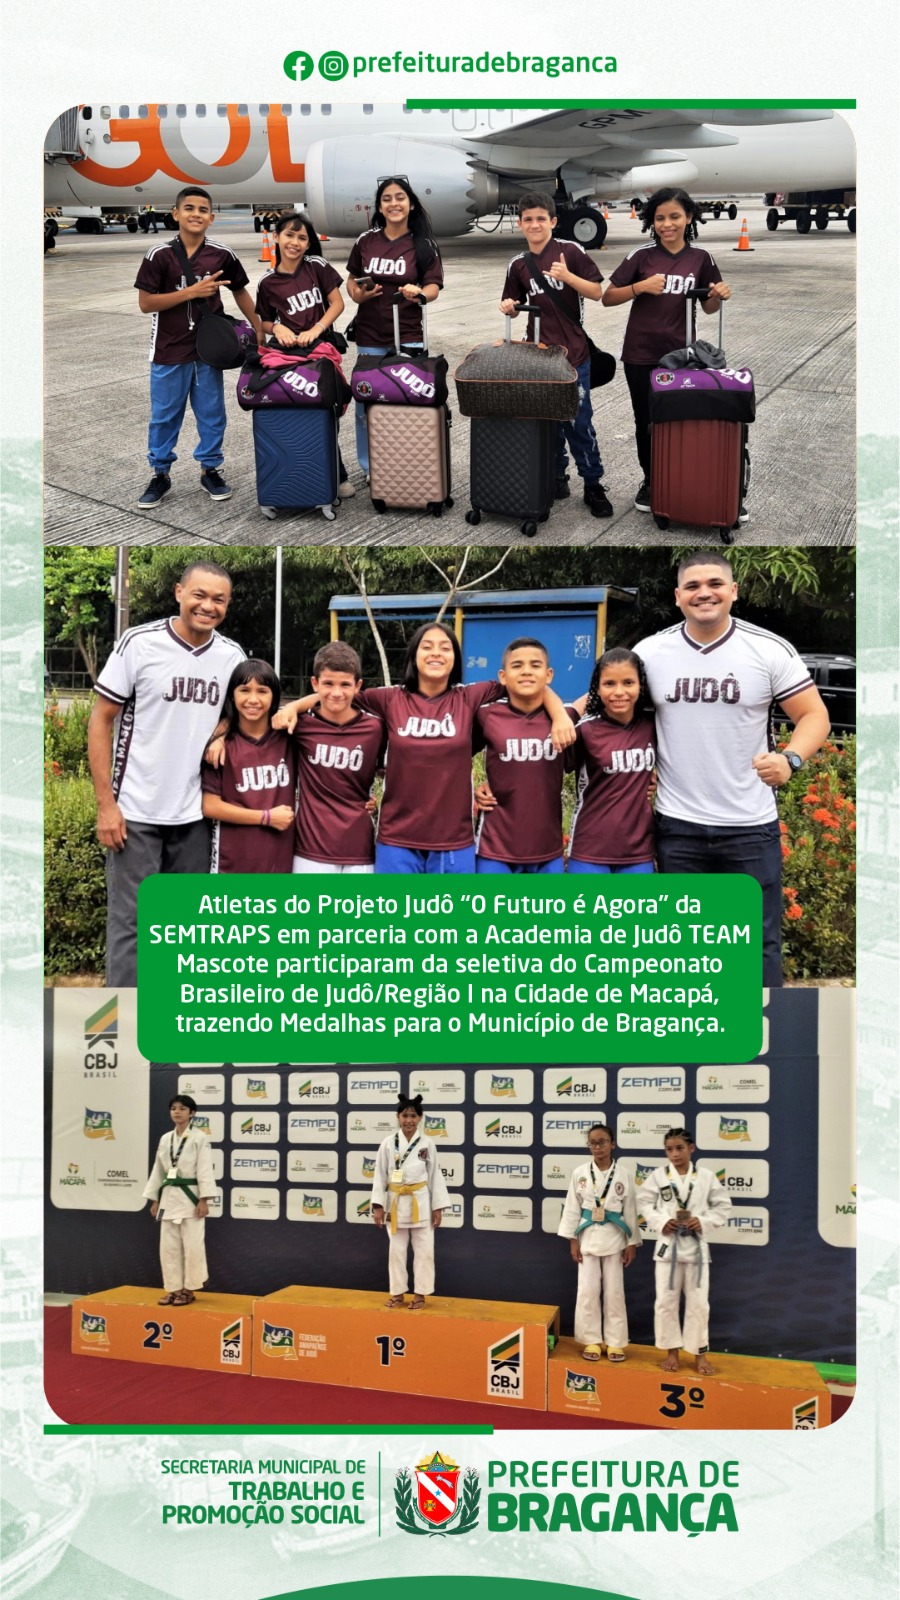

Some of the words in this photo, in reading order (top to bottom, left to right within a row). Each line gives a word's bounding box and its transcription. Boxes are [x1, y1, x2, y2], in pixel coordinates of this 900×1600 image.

[364, 256, 406, 276] JUDÔ
[656, 273, 696, 294] UDÔ
[281, 371, 319, 398] UDÔ
[391, 367, 436, 399] JUDÔ
[162, 676, 220, 706] JUDÔ
[665, 673, 740, 704] JUDÔ
[398, 713, 456, 737] JUDÔ
[308, 745, 363, 771] JUDÔ
[603, 742, 655, 774] JUDÔ
[236, 758, 289, 792] JUDÔ
[84, 1053, 118, 1069] CBJ
[351, 1081, 398, 1090] ZEMPO
[621, 1077, 682, 1087] ZEMPO
[312, 1086, 330, 1095] CBJ
[574, 1084, 596, 1093] CBJ
[254, 1124, 272, 1132] CBJ
[291, 1119, 336, 1128] ZEMPO
[502, 1125, 522, 1134] CBJ
[234, 1159, 277, 1168] ZEMPO
[107, 1170, 129, 1178] COMEL
[441, 1168, 454, 1177] BJ
[477, 1164, 529, 1174] ZEMPO
[727, 1177, 753, 1187] CBJ
[835, 1205, 857, 1214] MA
[222, 1349, 240, 1359] CBJ
[491, 1374, 519, 1389] CBJ
[491, 1387, 519, 1396] BRASIL
